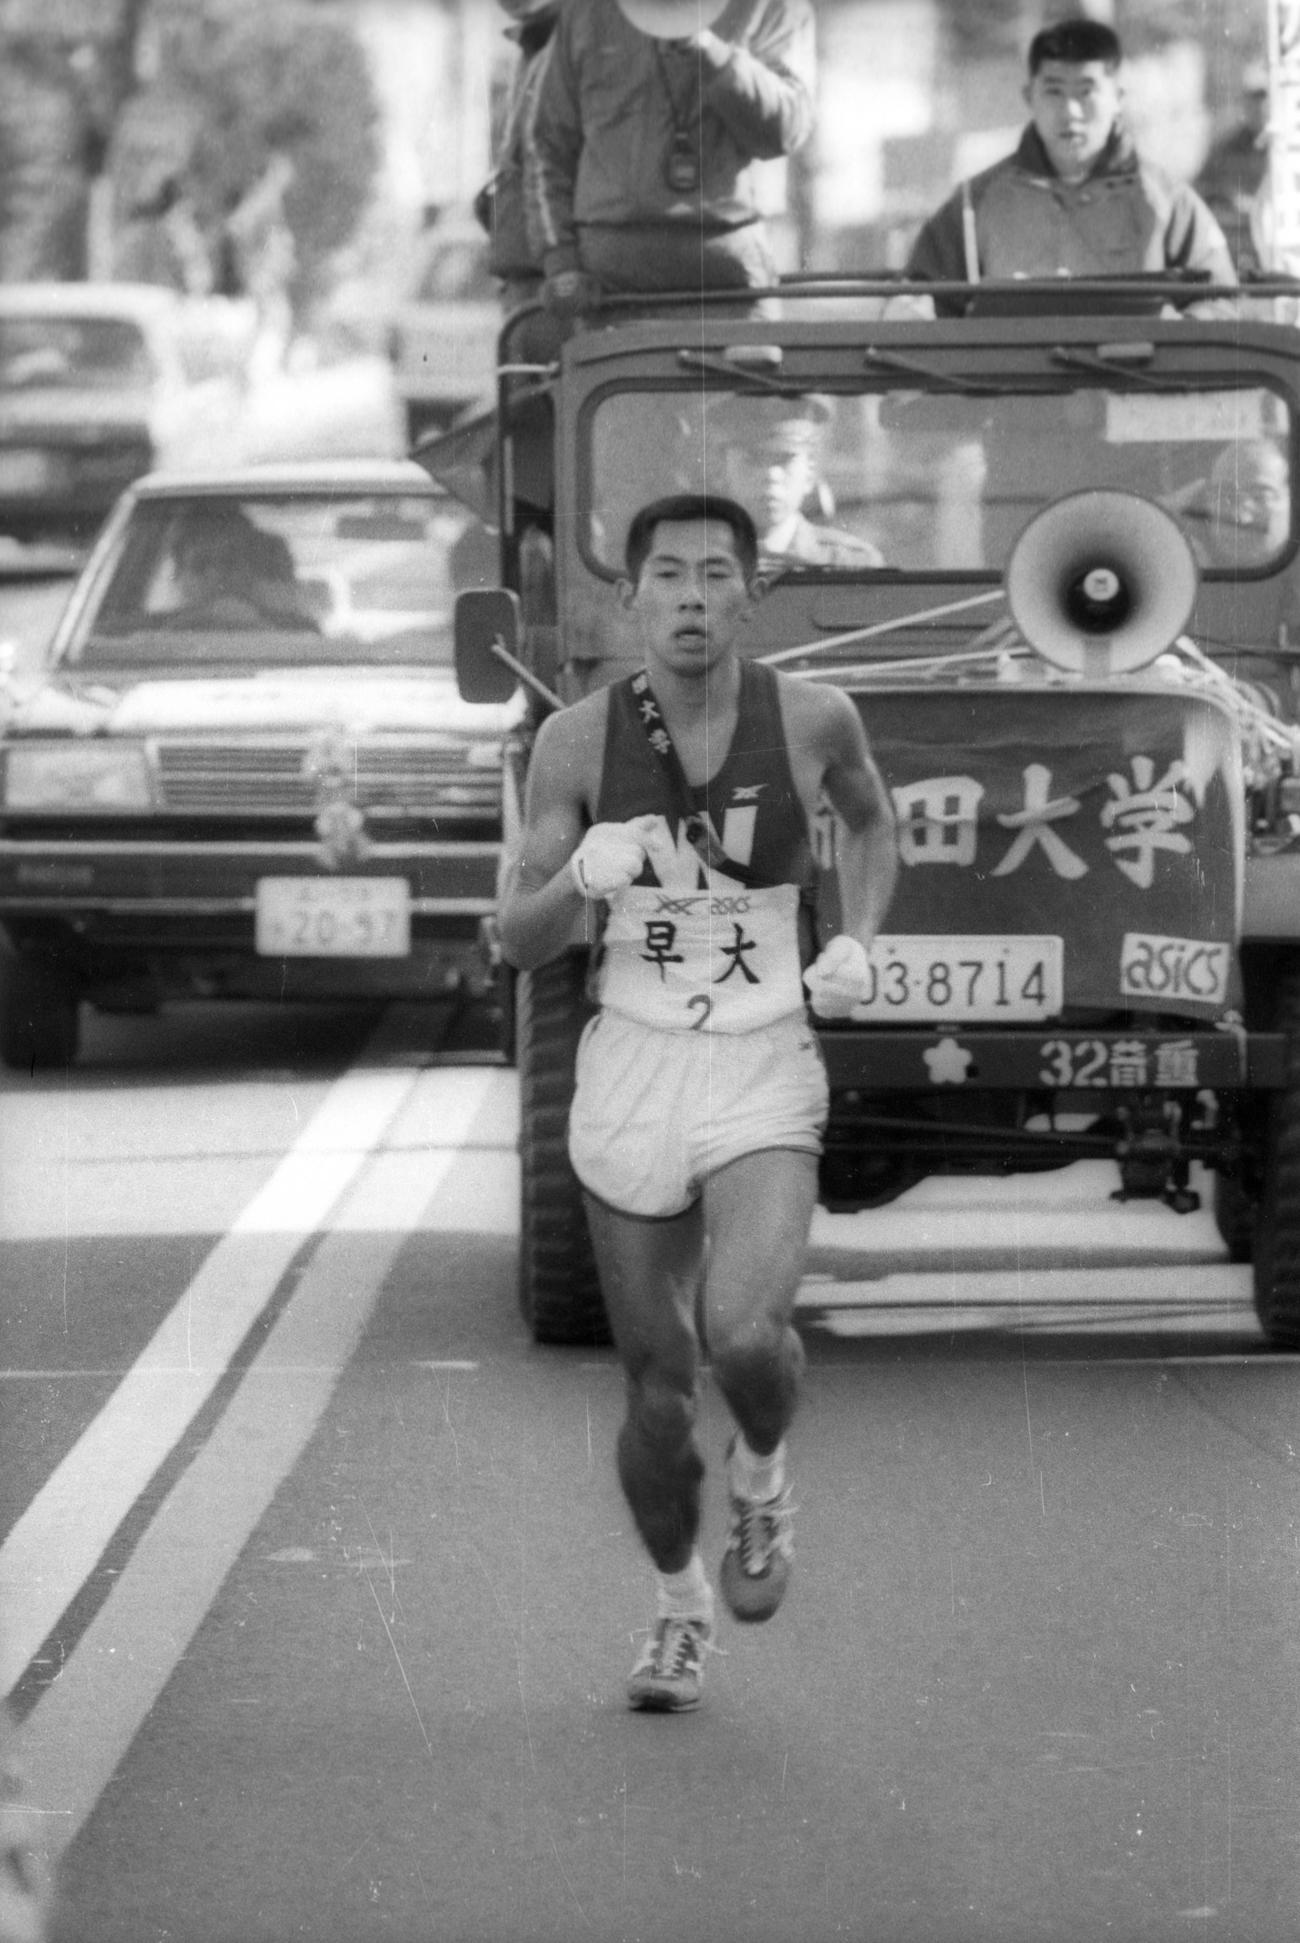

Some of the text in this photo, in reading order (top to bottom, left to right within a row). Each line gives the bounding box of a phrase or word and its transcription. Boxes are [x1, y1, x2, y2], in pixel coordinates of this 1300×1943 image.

[640, 920, 761, 983] 早大
[1126, 940, 1222, 996] asics
[686, 994, 713, 1031] 2
